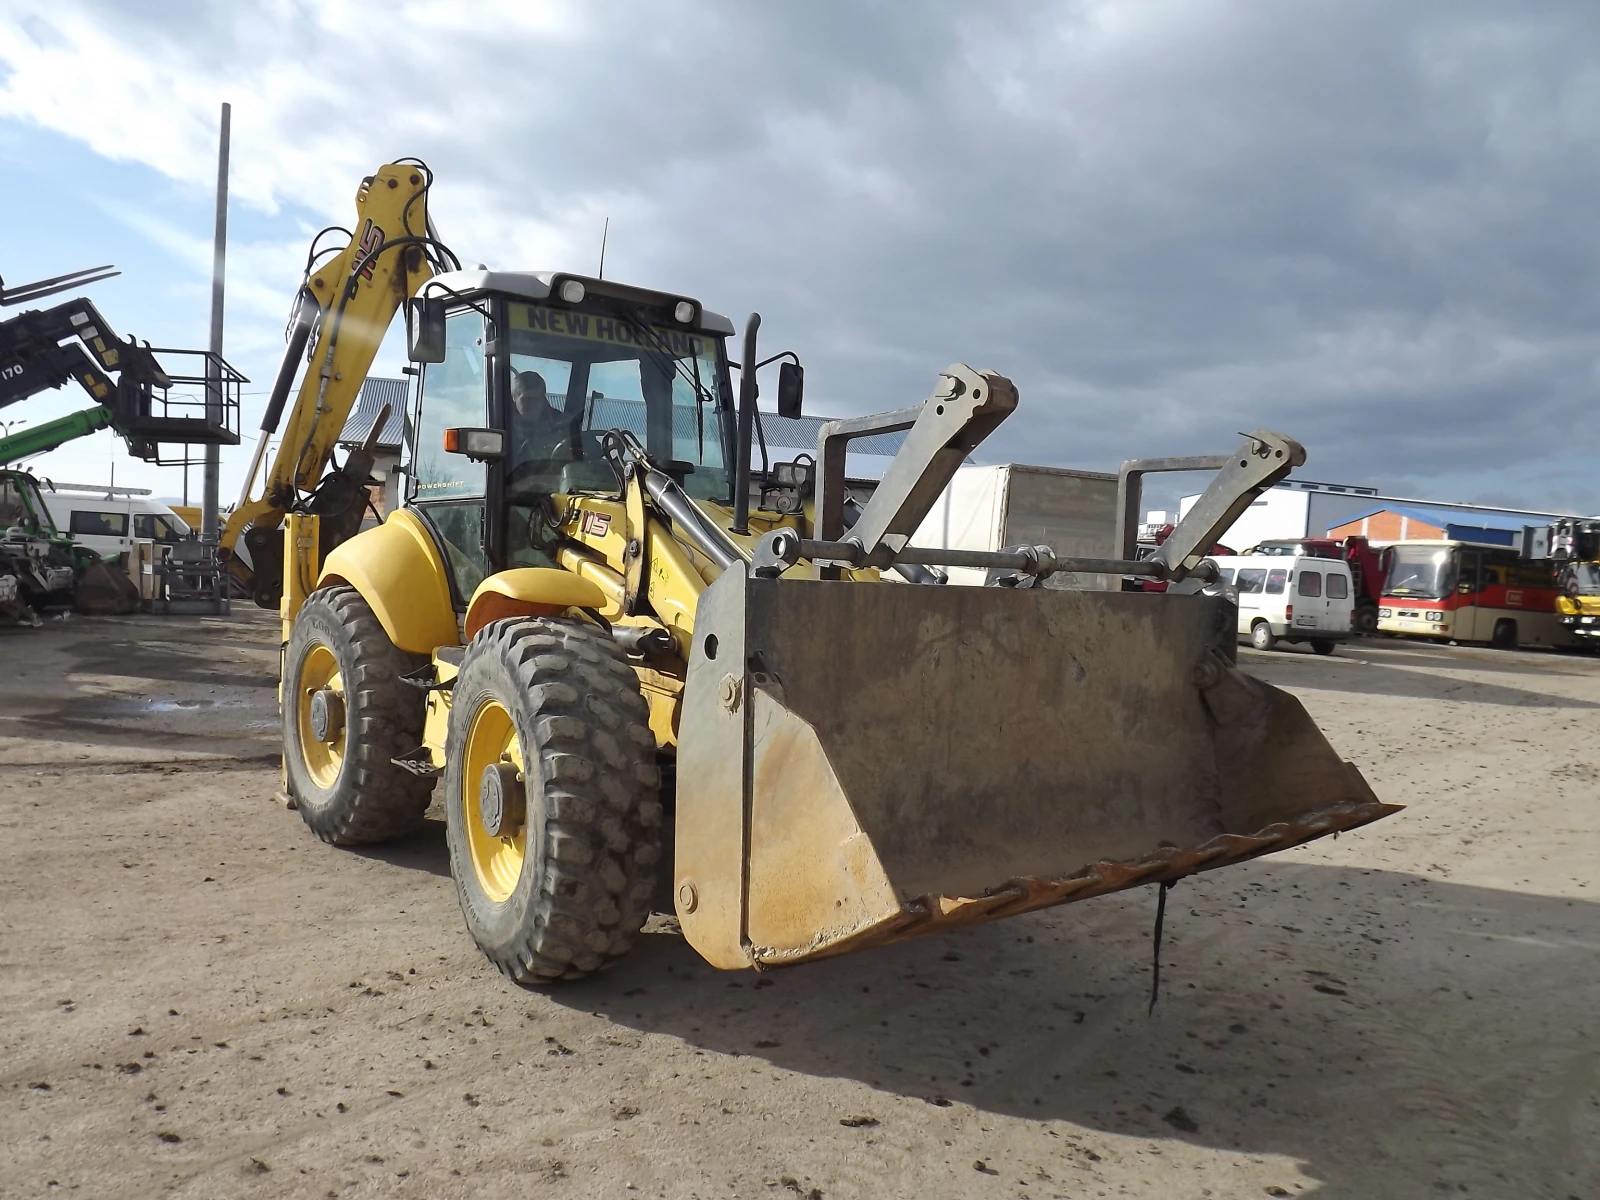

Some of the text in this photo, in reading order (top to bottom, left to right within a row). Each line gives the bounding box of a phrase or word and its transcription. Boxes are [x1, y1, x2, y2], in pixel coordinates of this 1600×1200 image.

[527, 306, 589, 337] NEW
[1, 364, 24, 381] 170
[417, 480, 465, 490] POWERSHIFT
[580, 509, 612, 538] 115
